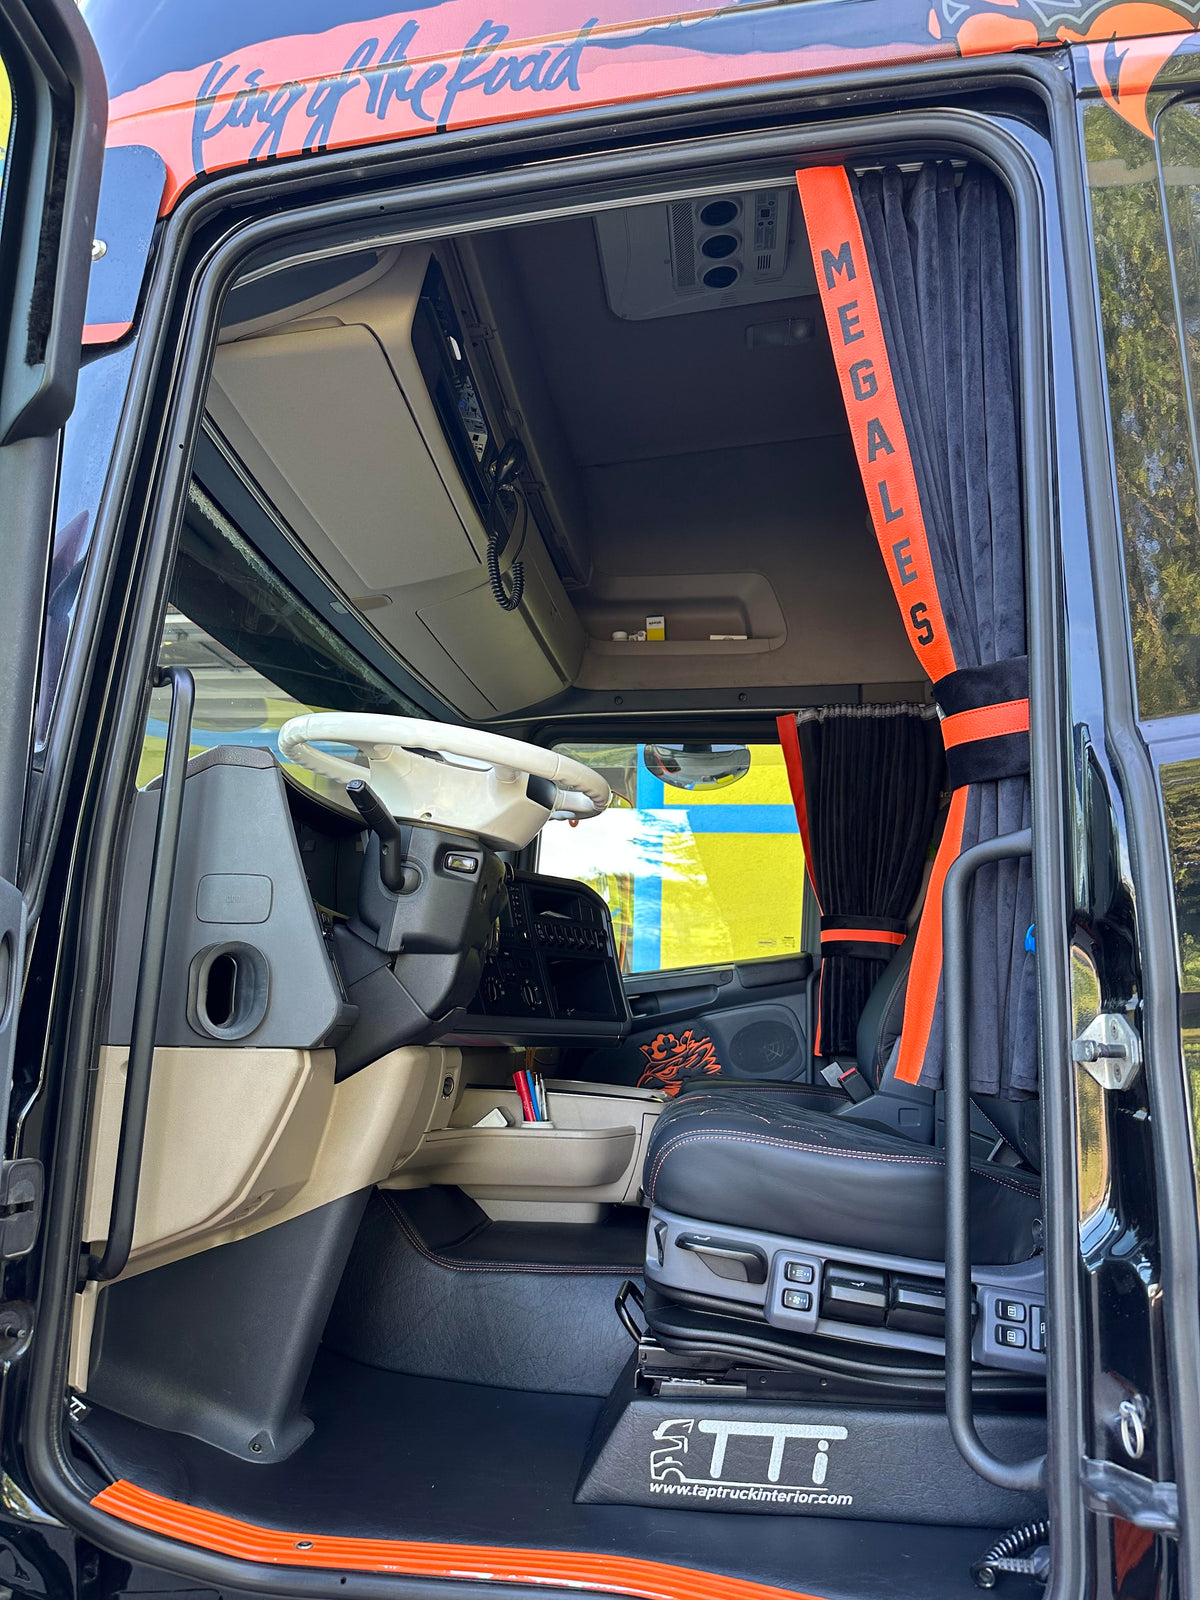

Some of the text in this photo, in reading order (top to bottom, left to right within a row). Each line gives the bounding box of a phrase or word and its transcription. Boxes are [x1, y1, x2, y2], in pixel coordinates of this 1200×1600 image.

[192, 60, 307, 176] King
[302, 37, 379, 153] of
[436, 17, 599, 133] Road
[820, 240, 935, 647] MEGALES
[650, 1482, 853, 1505] www.taptruckinterior.com
